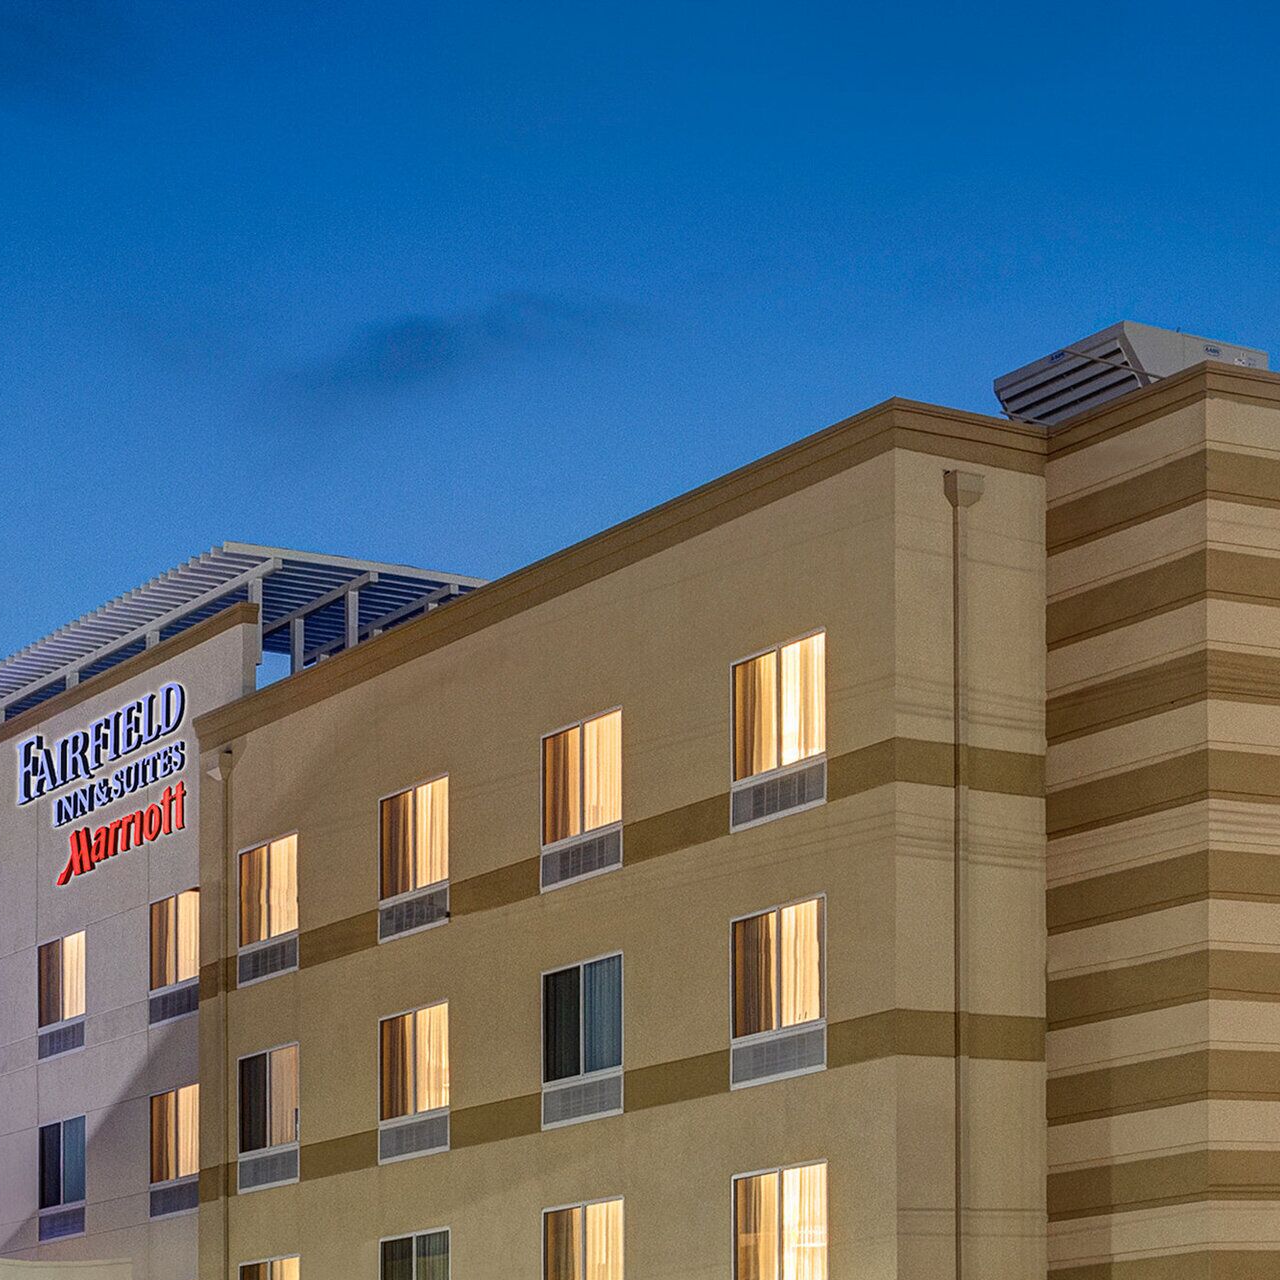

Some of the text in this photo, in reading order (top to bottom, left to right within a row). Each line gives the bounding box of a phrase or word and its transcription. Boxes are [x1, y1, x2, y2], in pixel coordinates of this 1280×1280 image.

[17, 683, 186, 806] FAIRFIELD
[53, 783, 96, 828] INN
[111, 741, 186, 799] SUITES
[56, 780, 187, 886] Marriott
